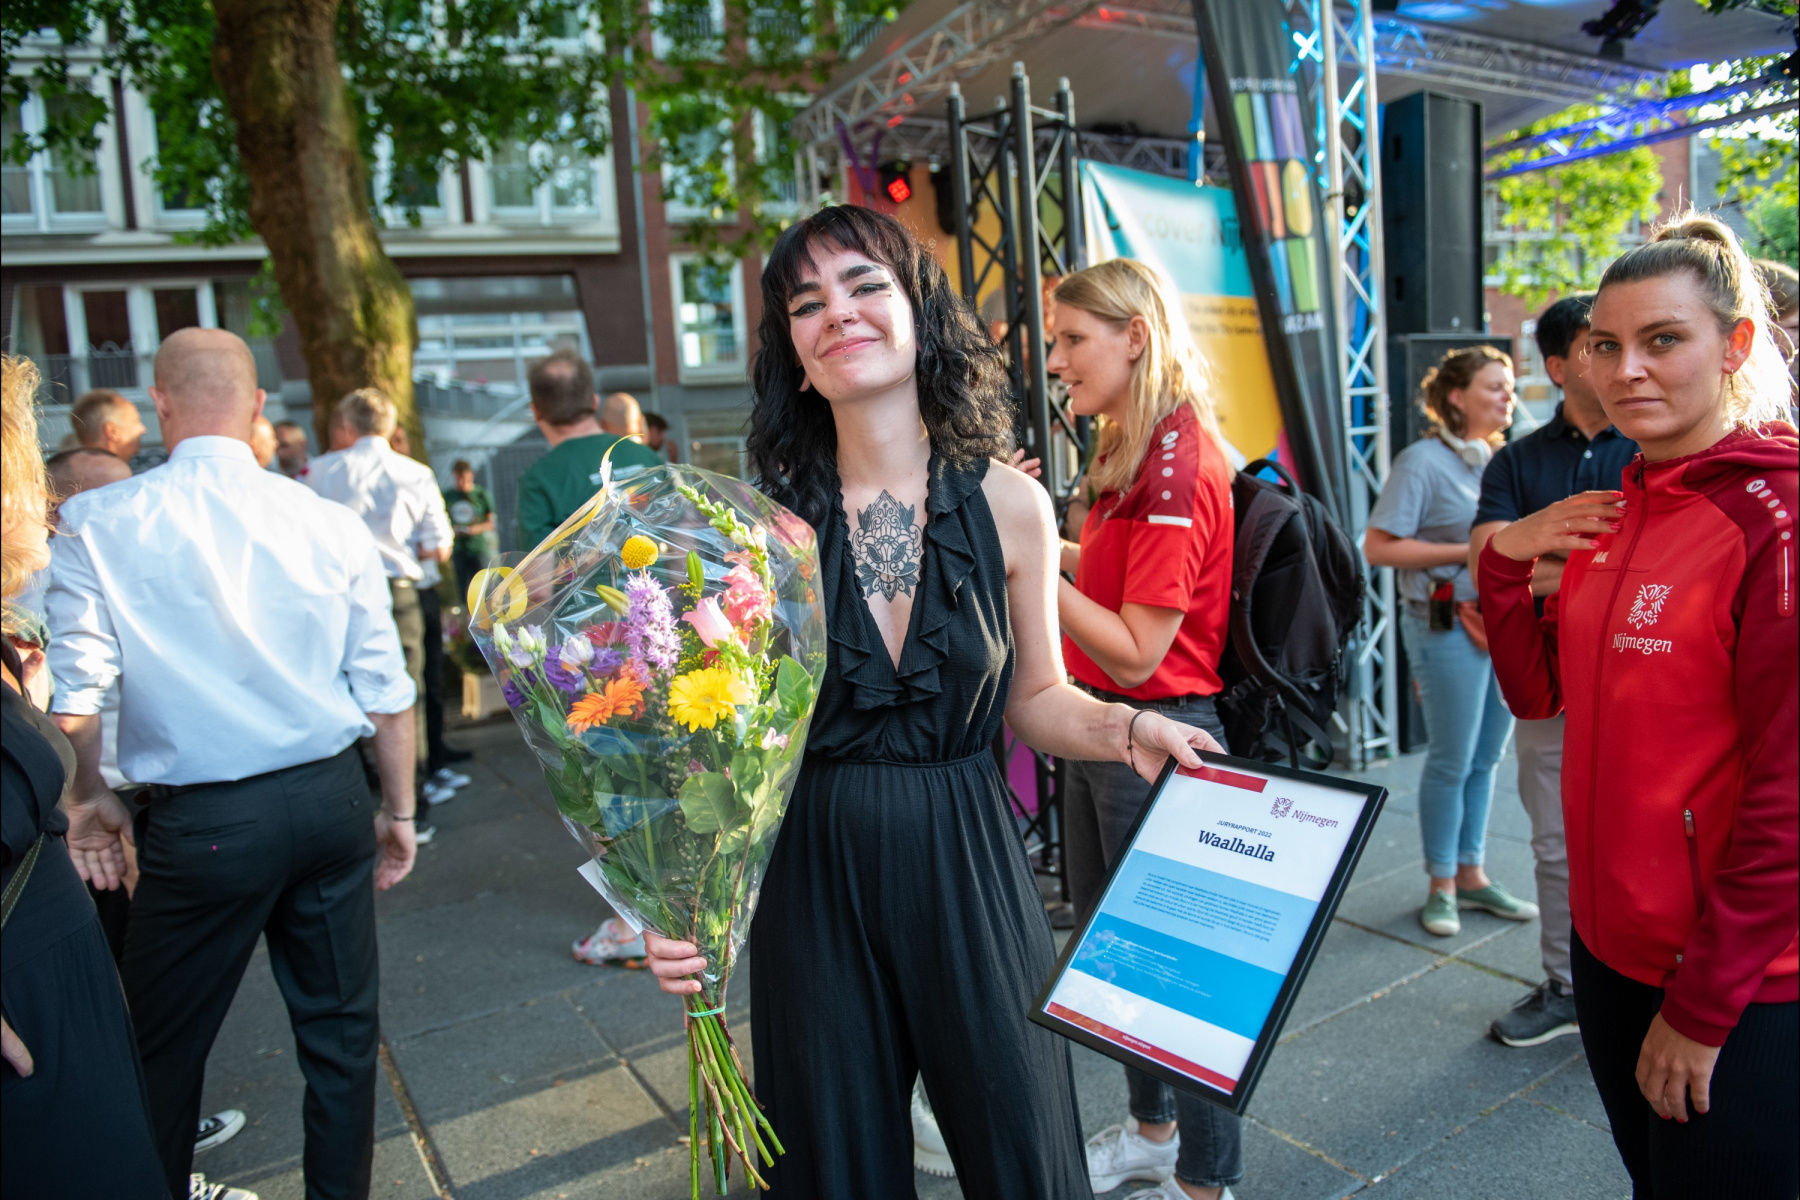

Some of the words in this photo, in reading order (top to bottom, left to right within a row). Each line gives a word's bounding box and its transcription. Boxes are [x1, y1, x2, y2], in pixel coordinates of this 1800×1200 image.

[1612, 632, 1673, 655] Nijmegen
[1291, 809, 1339, 828] Nijmegen
[1217, 820, 1258, 835] JURYRAPPORT
[1257, 830, 1272, 839] 2022
[1198, 830, 1275, 862] Waalhalla
